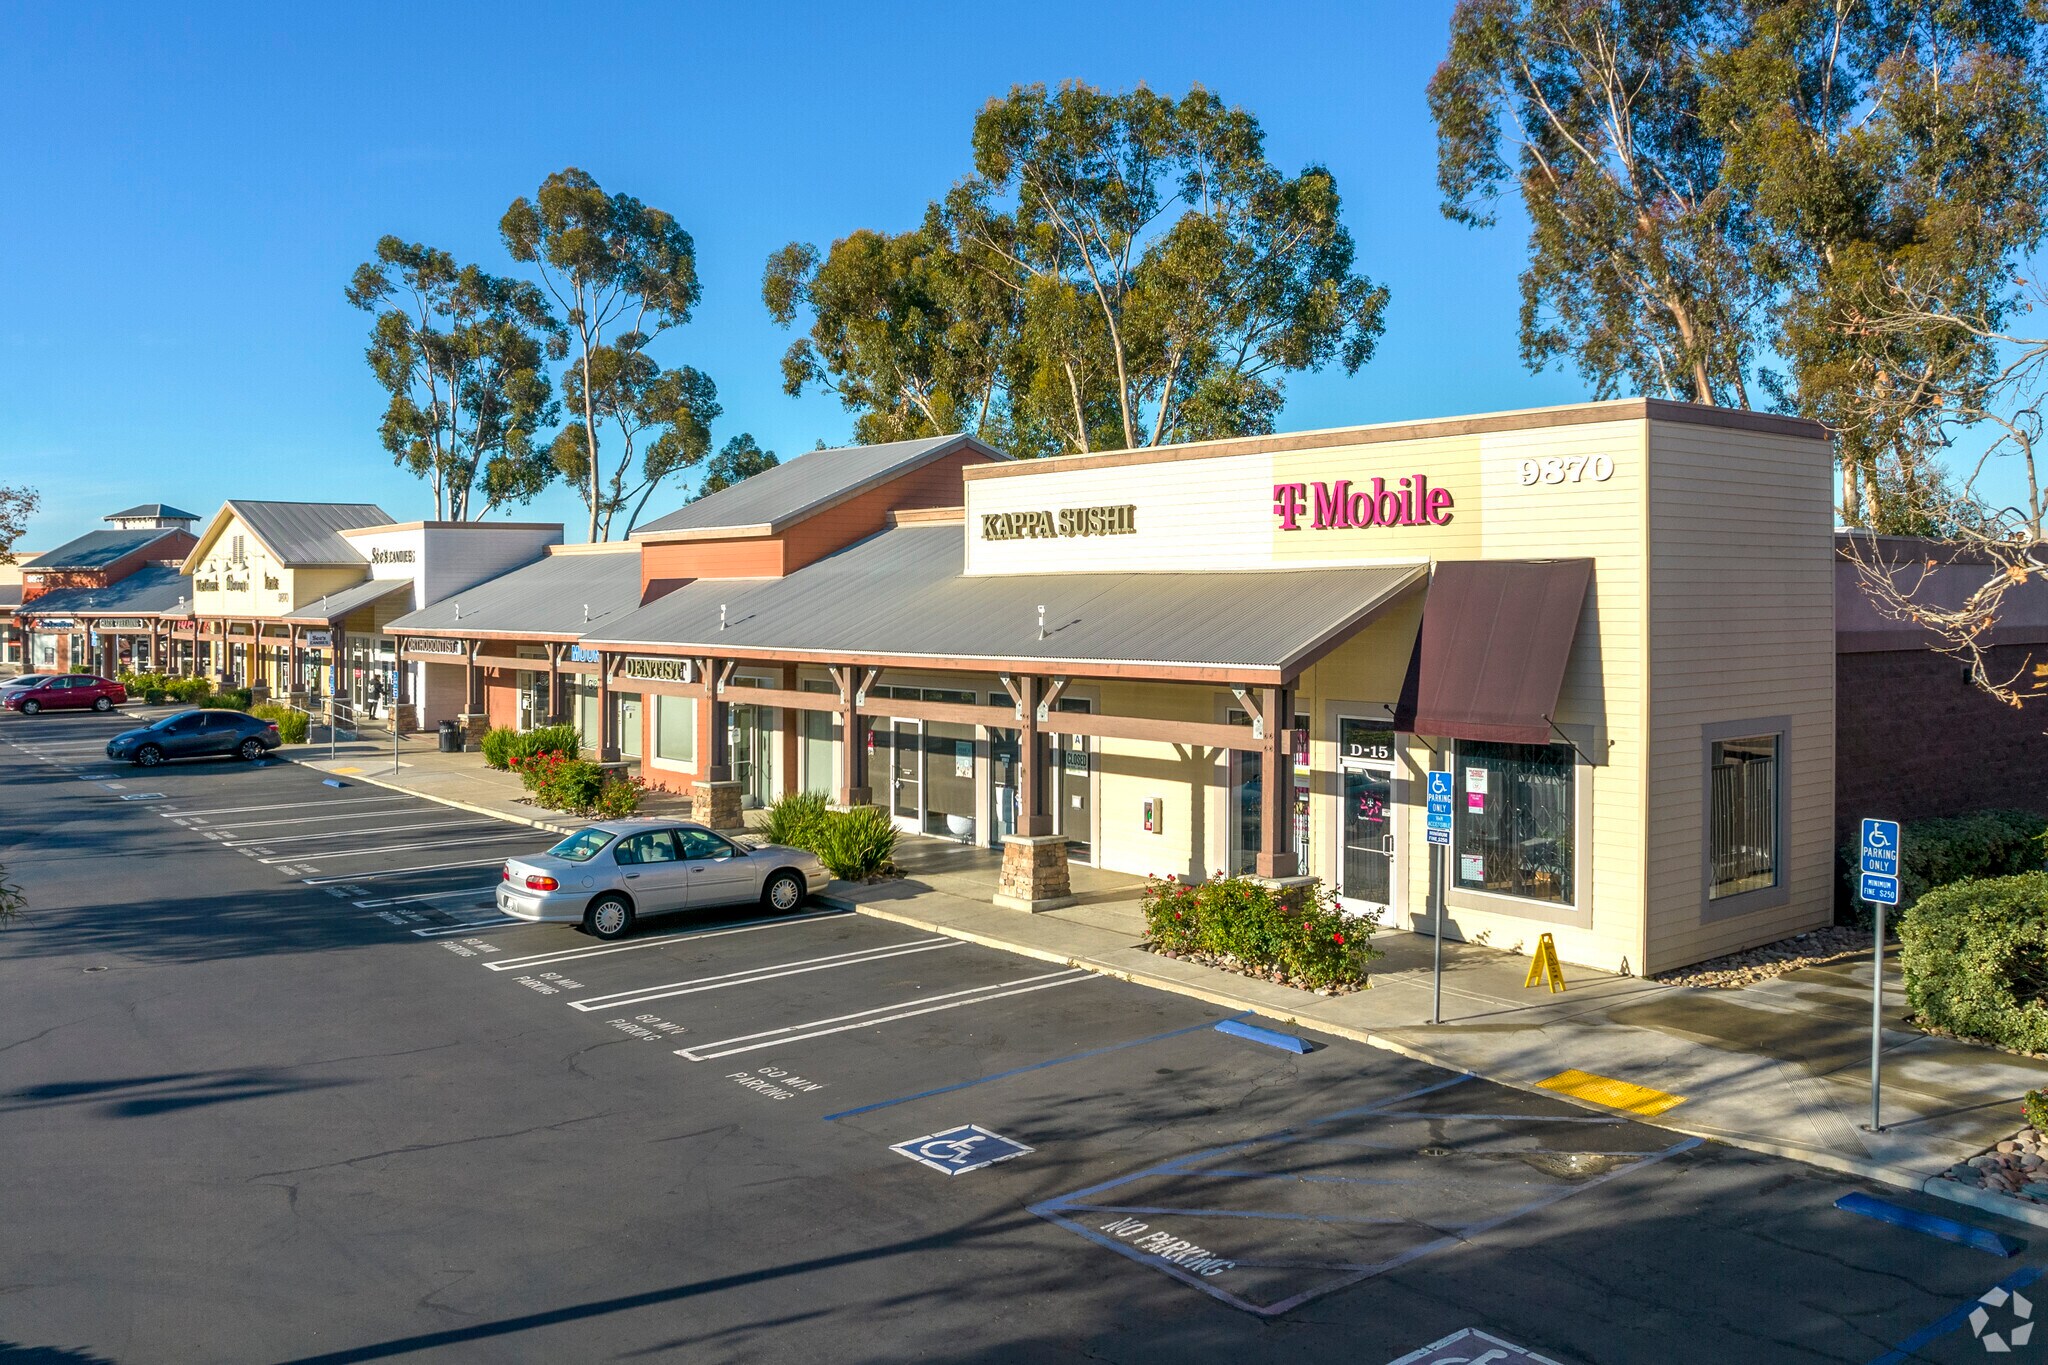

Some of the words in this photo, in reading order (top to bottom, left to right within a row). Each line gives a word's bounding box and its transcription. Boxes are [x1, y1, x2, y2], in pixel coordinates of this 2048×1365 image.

[1519, 453, 1615, 487] 9870
[1310, 474, 1454, 530] Mobile
[981, 511, 1058, 541] KAPPA
[1058, 504, 1138, 539] SUSHI
[407, 639, 456, 654] ORTHODONTIST
[625, 658, 682, 681] DENTIST
[1067, 752, 1087, 767] CLOSED
[1350, 743, 1389, 759] D-15
[1428, 794, 1451, 804] PARKING
[1432, 804, 1446, 813] ONLY
[1863, 846, 1896, 861] PARKING
[1869, 860, 1889, 872] ONLY
[1864, 887, 1876, 896] FINE
[1879, 889, 1895, 899] $250
[1868, 879, 1891, 889] MINIMUM
[512, 975, 560, 995] PARKING
[605, 1018, 662, 1042] PARKING
[635, 1013, 662, 1024] 60
[653, 1020, 688, 1035] MIN
[725, 1071, 795, 1101] PARKING
[757, 1066, 788, 1078] 60
[781, 1076, 824, 1092] MIN
[1100, 1217, 1149, 1237] NO
[1133, 1231, 1236, 1277] PARKING
